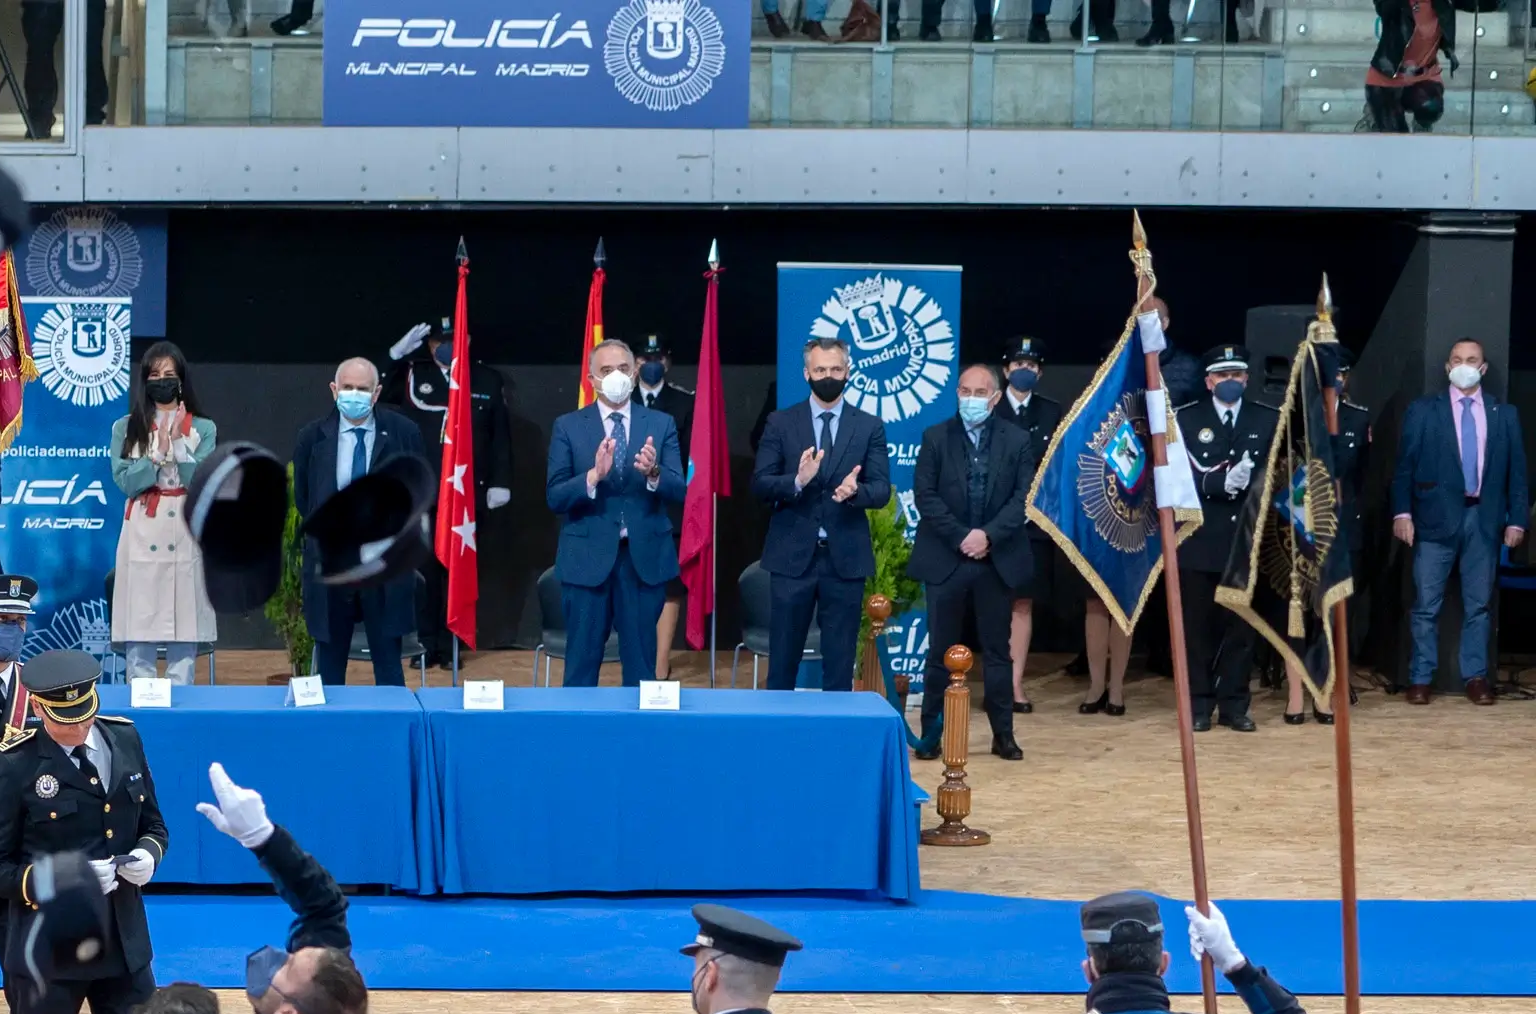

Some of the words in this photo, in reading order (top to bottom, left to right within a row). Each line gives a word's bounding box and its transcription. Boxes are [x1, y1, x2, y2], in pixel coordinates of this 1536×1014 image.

[351, 12, 593, 49] POLICÍA
[345, 62, 477, 76] MUNICIPAL
[495, 63, 590, 77] MADRID
[629, 26, 644, 70] POLICÍA
[637, 67, 692, 86] MUNICIPAL
[685, 26, 700, 68] MADRID
[55, 327, 68, 369] POLICÍA
[63, 364, 115, 384] MUNICIPAL
[108, 327, 123, 367] MADRID
[858, 341, 910, 369] madrid
[884, 315, 925, 394] MUNICIPAL
[22, 517, 105, 529] MADRID
